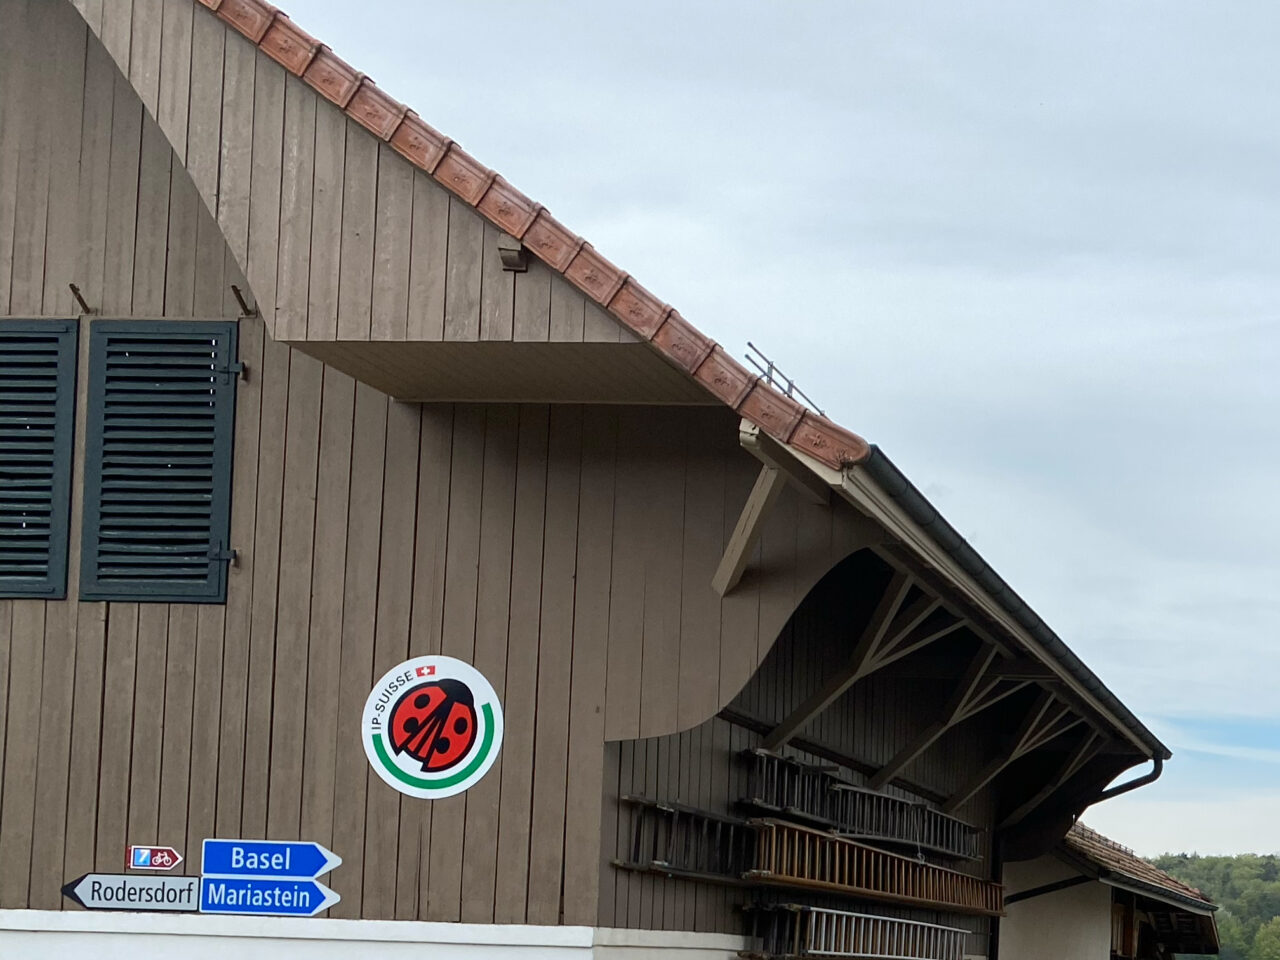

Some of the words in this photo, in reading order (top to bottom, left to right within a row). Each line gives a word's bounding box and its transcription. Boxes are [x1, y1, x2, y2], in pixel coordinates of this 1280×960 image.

[371, 670, 414, 730] IP-SUISSE
[140, 849, 150, 863] 7
[231, 847, 291, 870] Basel
[91, 880, 194, 904] Rodersdorf
[208, 883, 310, 908] Mariastein
